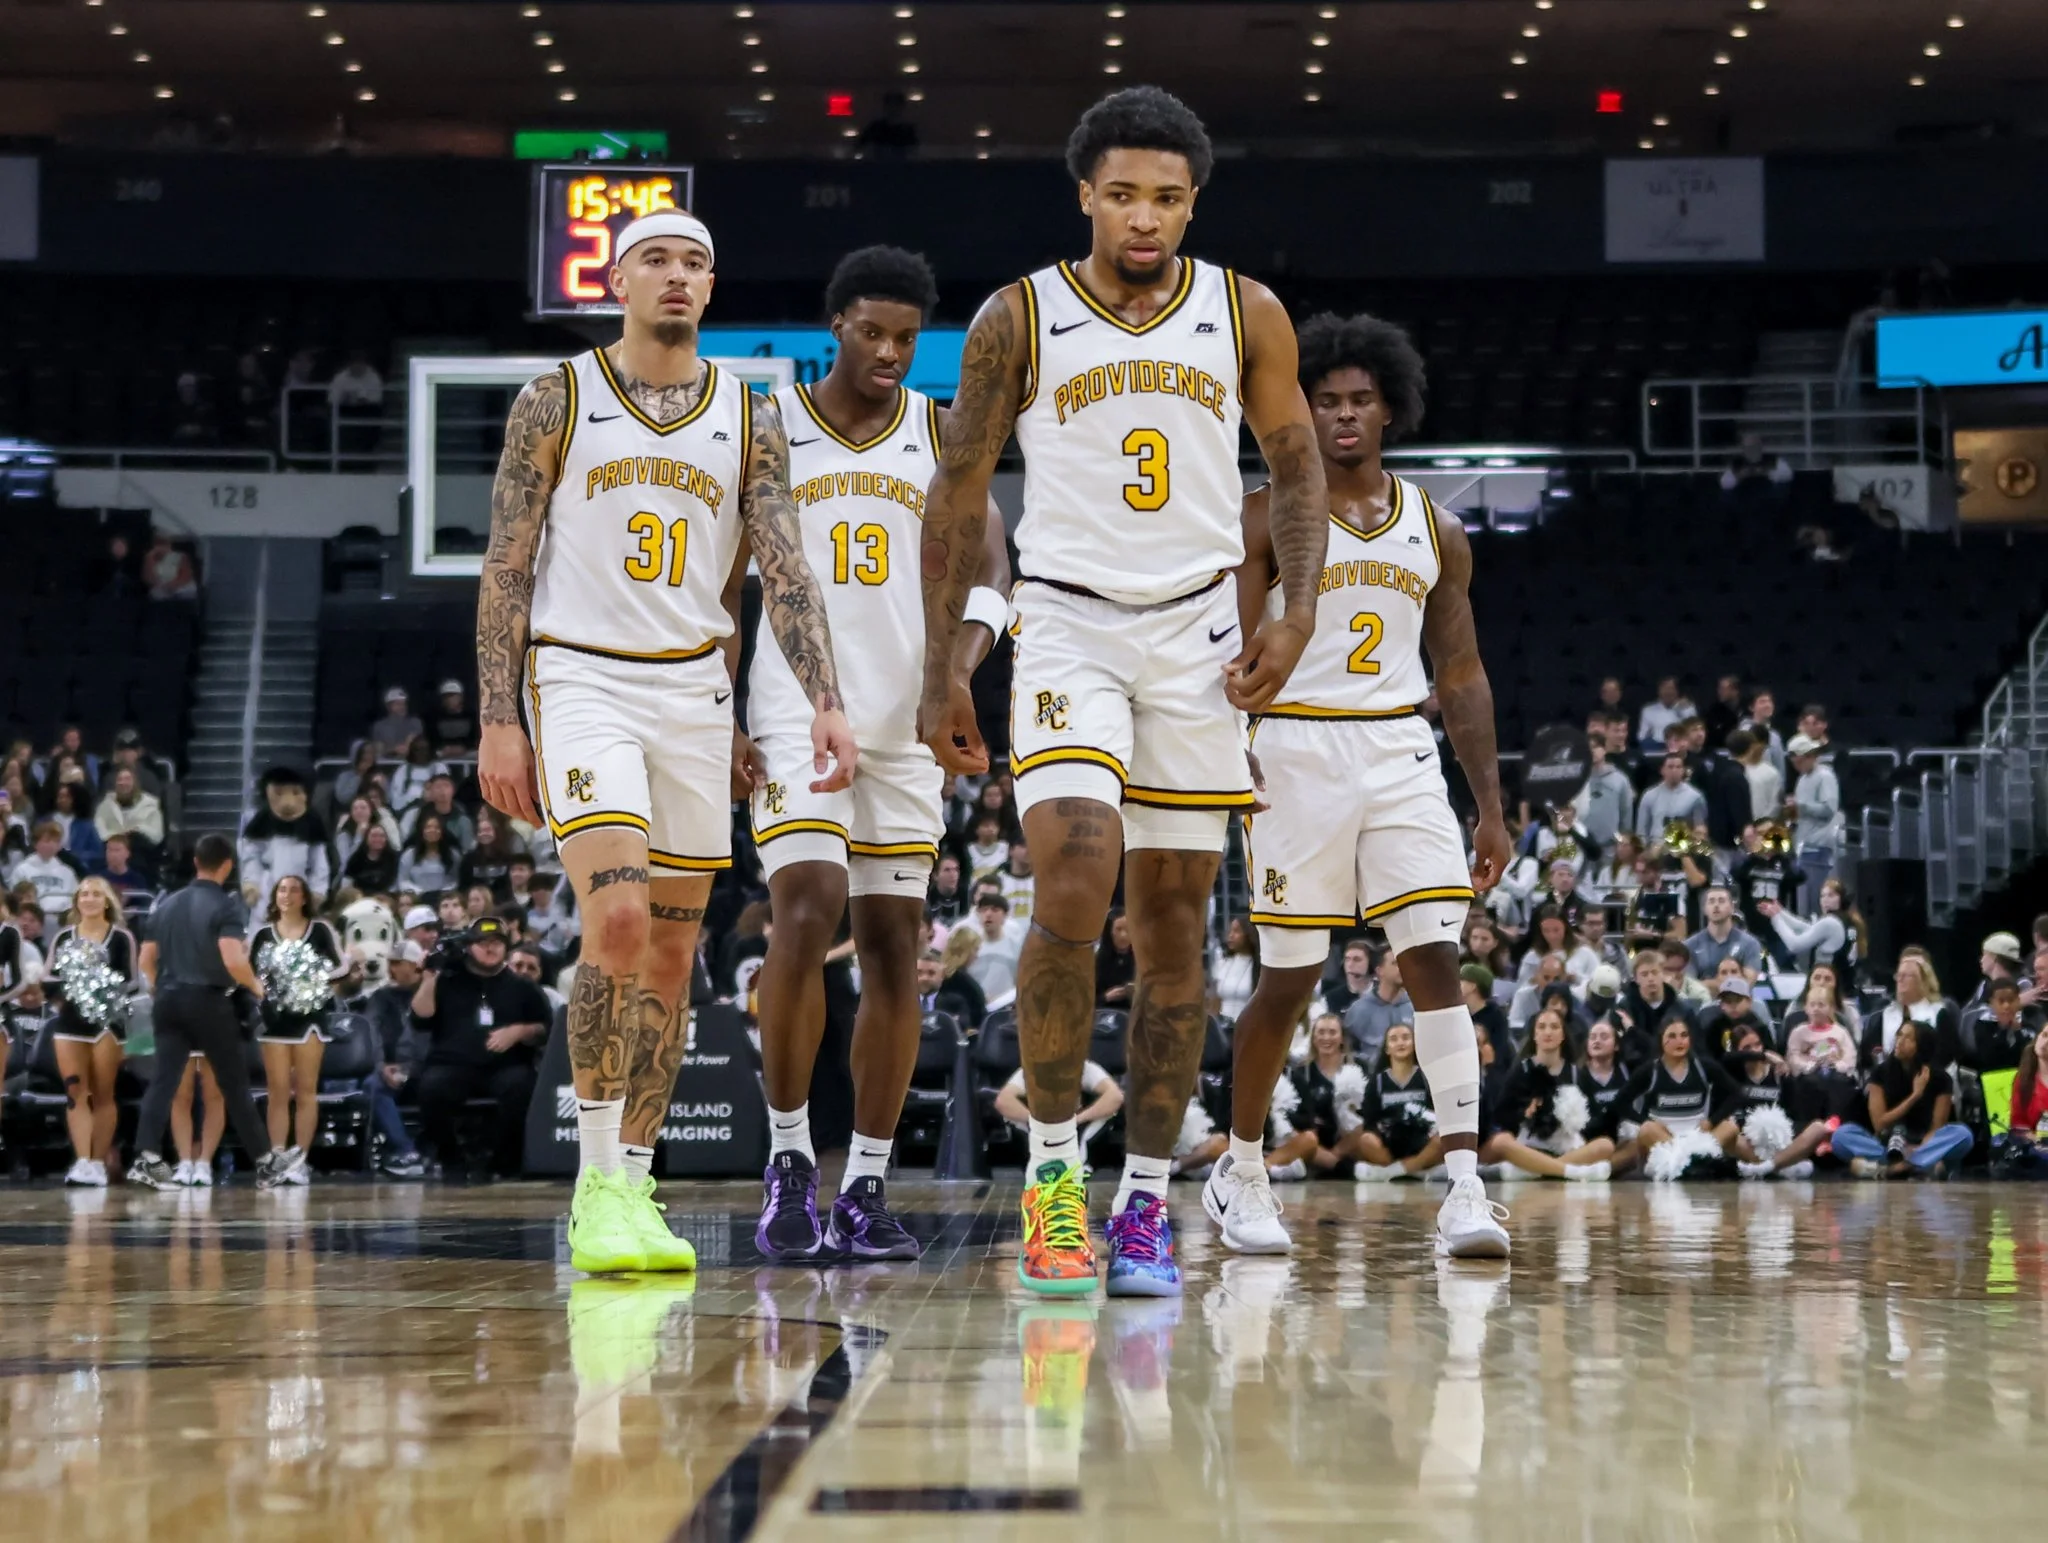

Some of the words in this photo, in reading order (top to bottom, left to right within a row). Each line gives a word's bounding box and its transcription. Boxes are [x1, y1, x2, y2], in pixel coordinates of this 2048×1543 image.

[1054, 359, 1227, 426] PROVIDENCE
[210, 485, 258, 509] 128
[586, 456, 725, 521] PROVIDENCE
[791, 471, 928, 522] PROVIDENCE
[1122, 427, 1170, 512] 3
[623, 510, 689, 588] 31
[830, 521, 890, 586] 13
[1318, 559, 1429, 611] ROVIDENCE
[1346, 611, 1384, 675] 2
[697, 1053, 731, 1065] Power
[657, 1126, 733, 1141] MAGING
[670, 1103, 733, 1118] ISLAND
